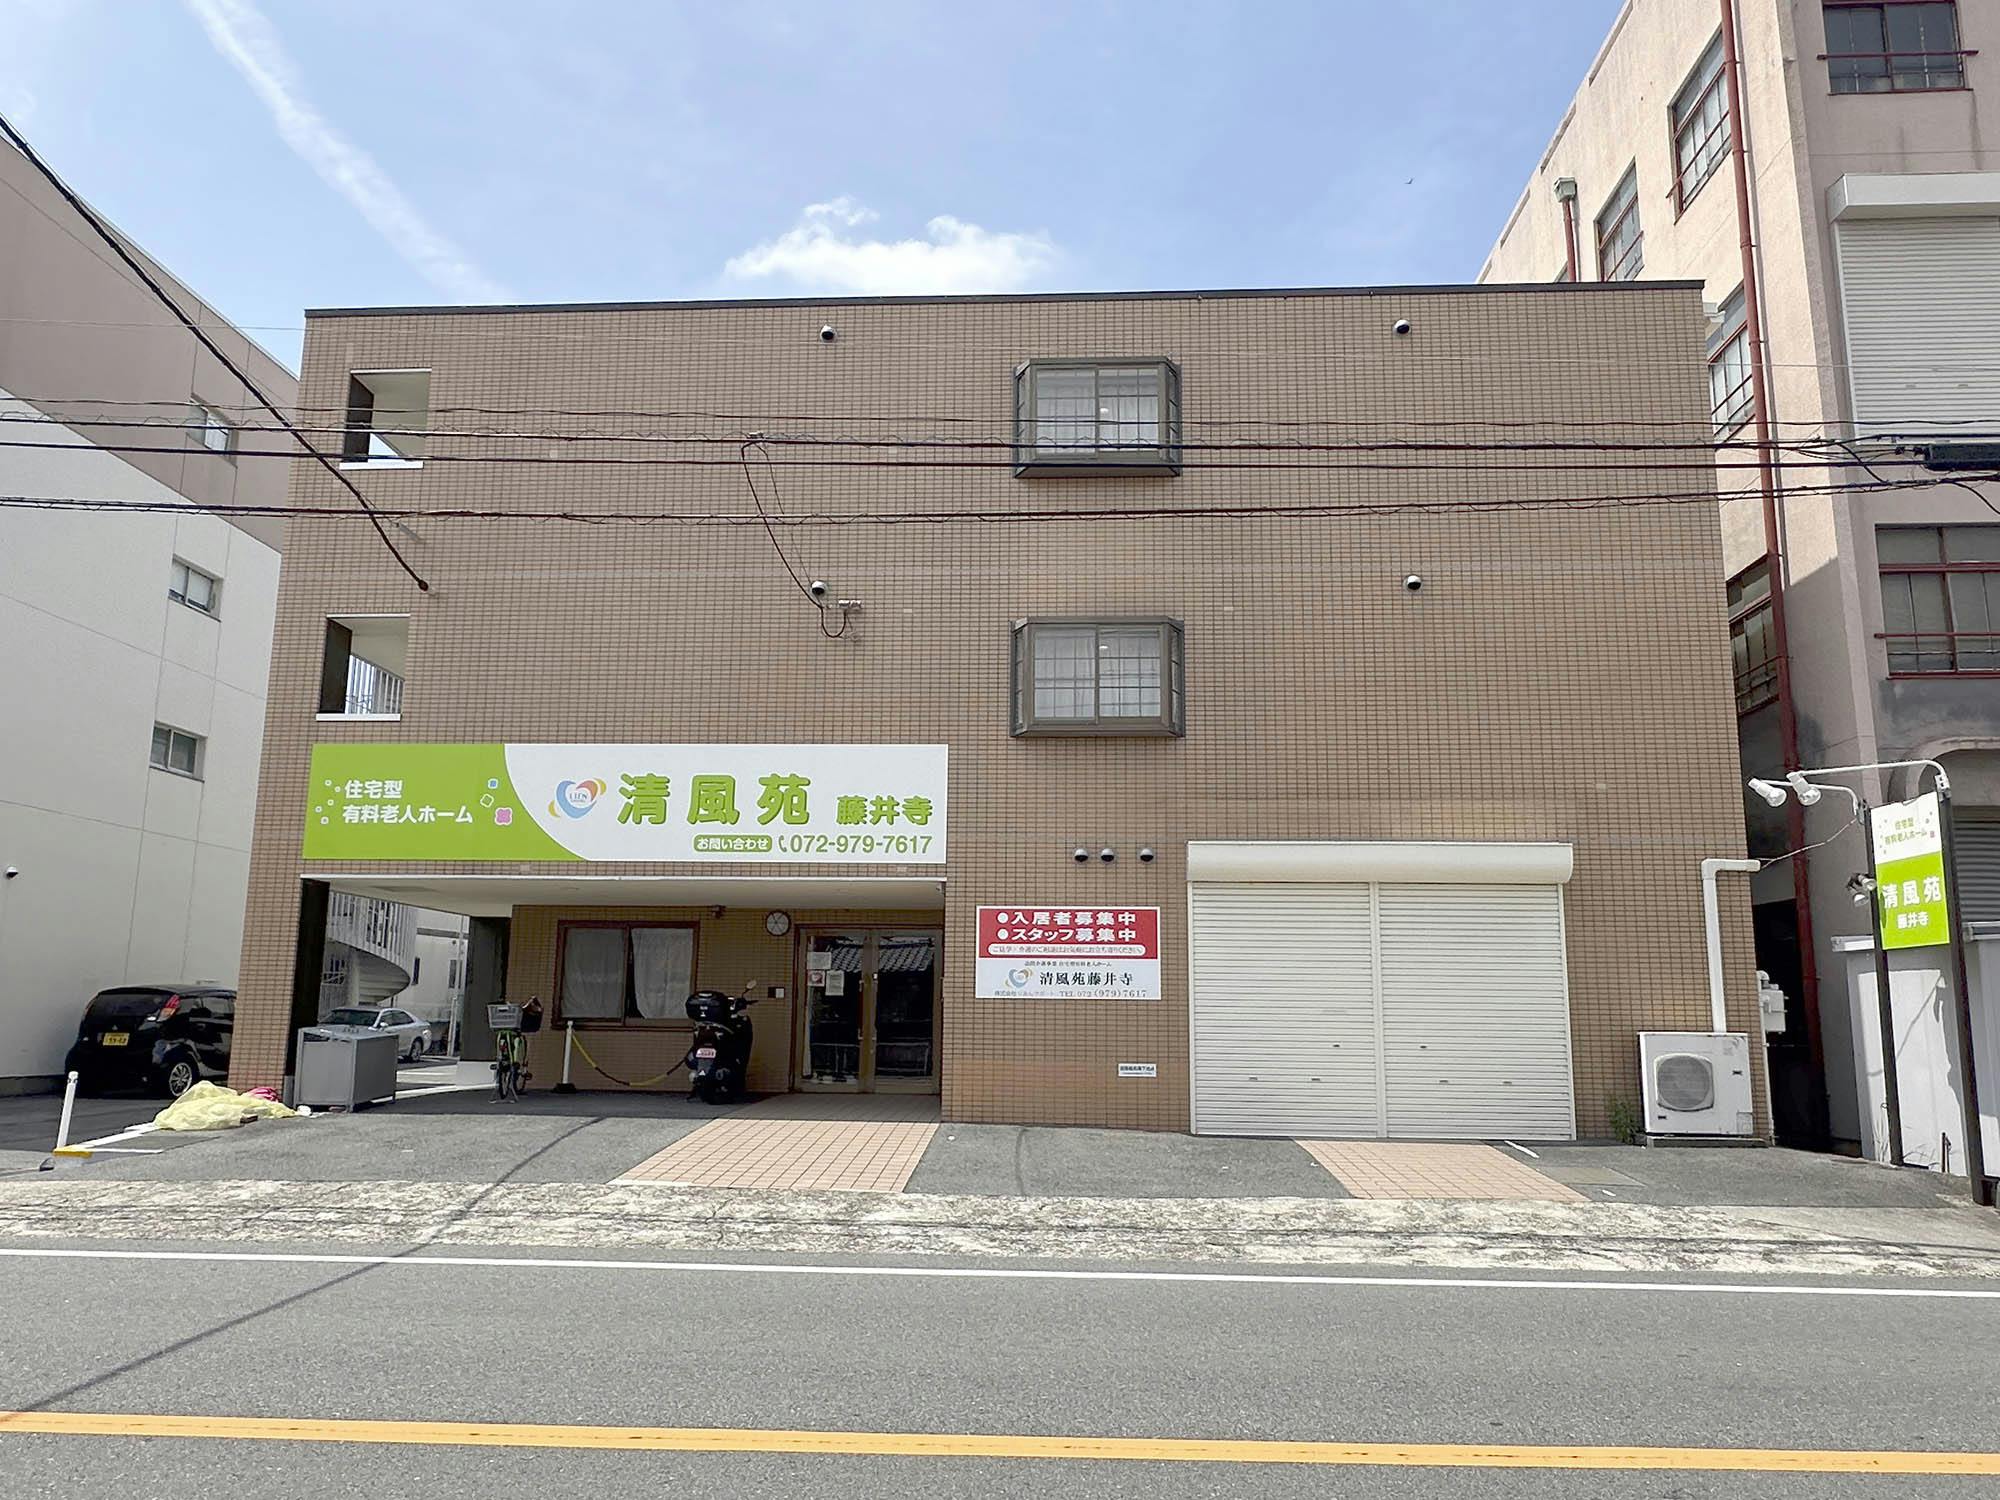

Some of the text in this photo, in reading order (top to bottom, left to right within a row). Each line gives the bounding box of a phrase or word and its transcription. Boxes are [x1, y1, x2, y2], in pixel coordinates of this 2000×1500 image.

[344, 779, 403, 799] 住宅型
[616, 771, 933, 826] 清風苑 藤井寺
[342, 804, 474, 824] 有料老人ホーム
[696, 834, 933, 854] お問い合わせ 072-979-7617
[1882, 875, 1942, 909] 清風苑
[1039, 971, 1133, 986] 清風苑藤井寺
